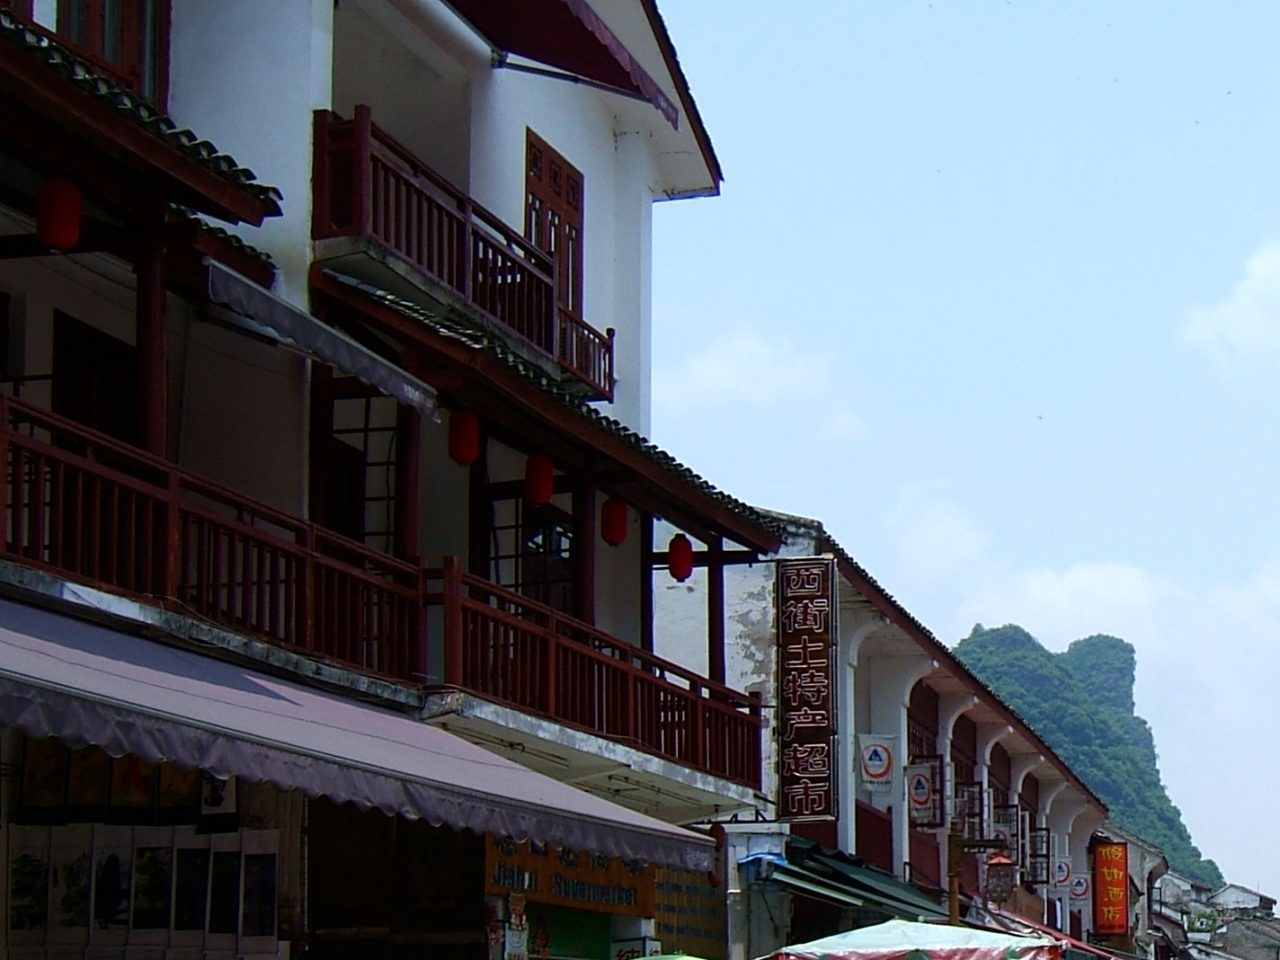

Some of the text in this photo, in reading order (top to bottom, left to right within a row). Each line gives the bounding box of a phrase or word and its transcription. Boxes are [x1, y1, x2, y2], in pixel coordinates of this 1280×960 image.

[784, 566, 829, 814] 西街土特产超市
[553, 873, 637, 907] Supermarket
